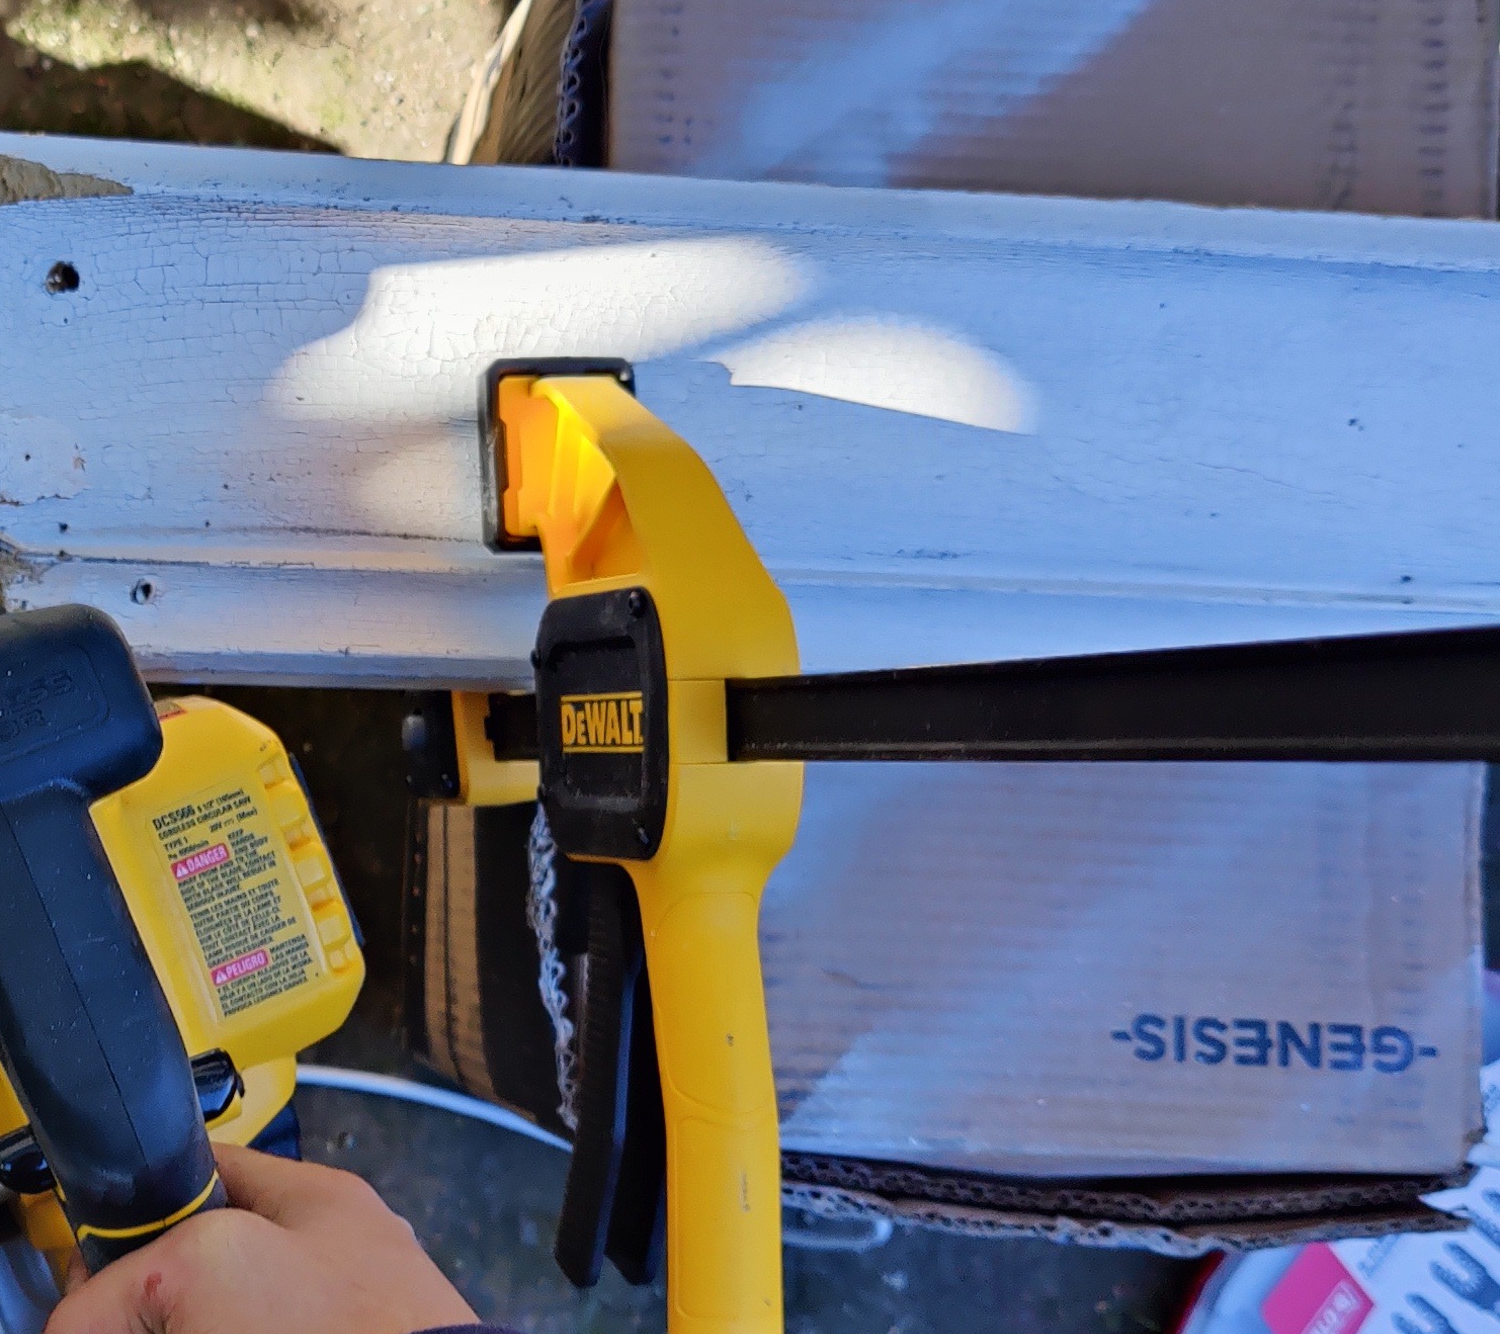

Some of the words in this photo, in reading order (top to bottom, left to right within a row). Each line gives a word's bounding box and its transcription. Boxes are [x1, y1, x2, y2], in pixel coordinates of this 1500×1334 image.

[196, 804, 232, 824] CIRCULAR
[233, 796, 251, 809] SAW
[164, 839, 182, 852] TYPE
[186, 845, 227, 872] DANGER
[234, 845, 248, 855] AND
[225, 953, 265, 979] PELIGRO
